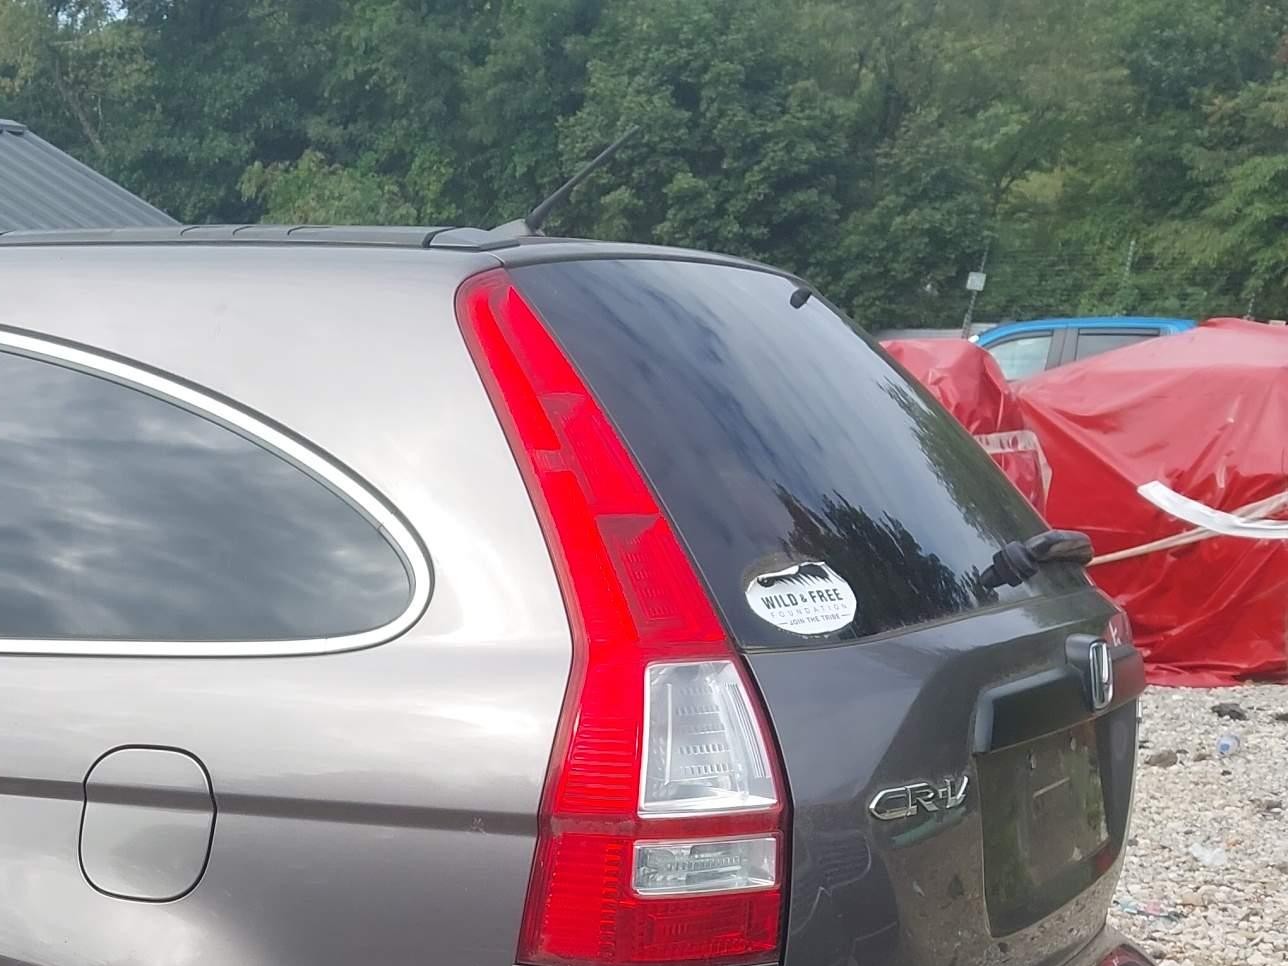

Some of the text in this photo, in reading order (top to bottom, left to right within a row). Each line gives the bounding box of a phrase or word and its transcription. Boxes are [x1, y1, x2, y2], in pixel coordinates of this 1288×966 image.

[761, 588, 843, 609] WILD & FREE
[770, 604, 847, 618] FOUNDATION
[869, 775, 968, 820] CR-V
